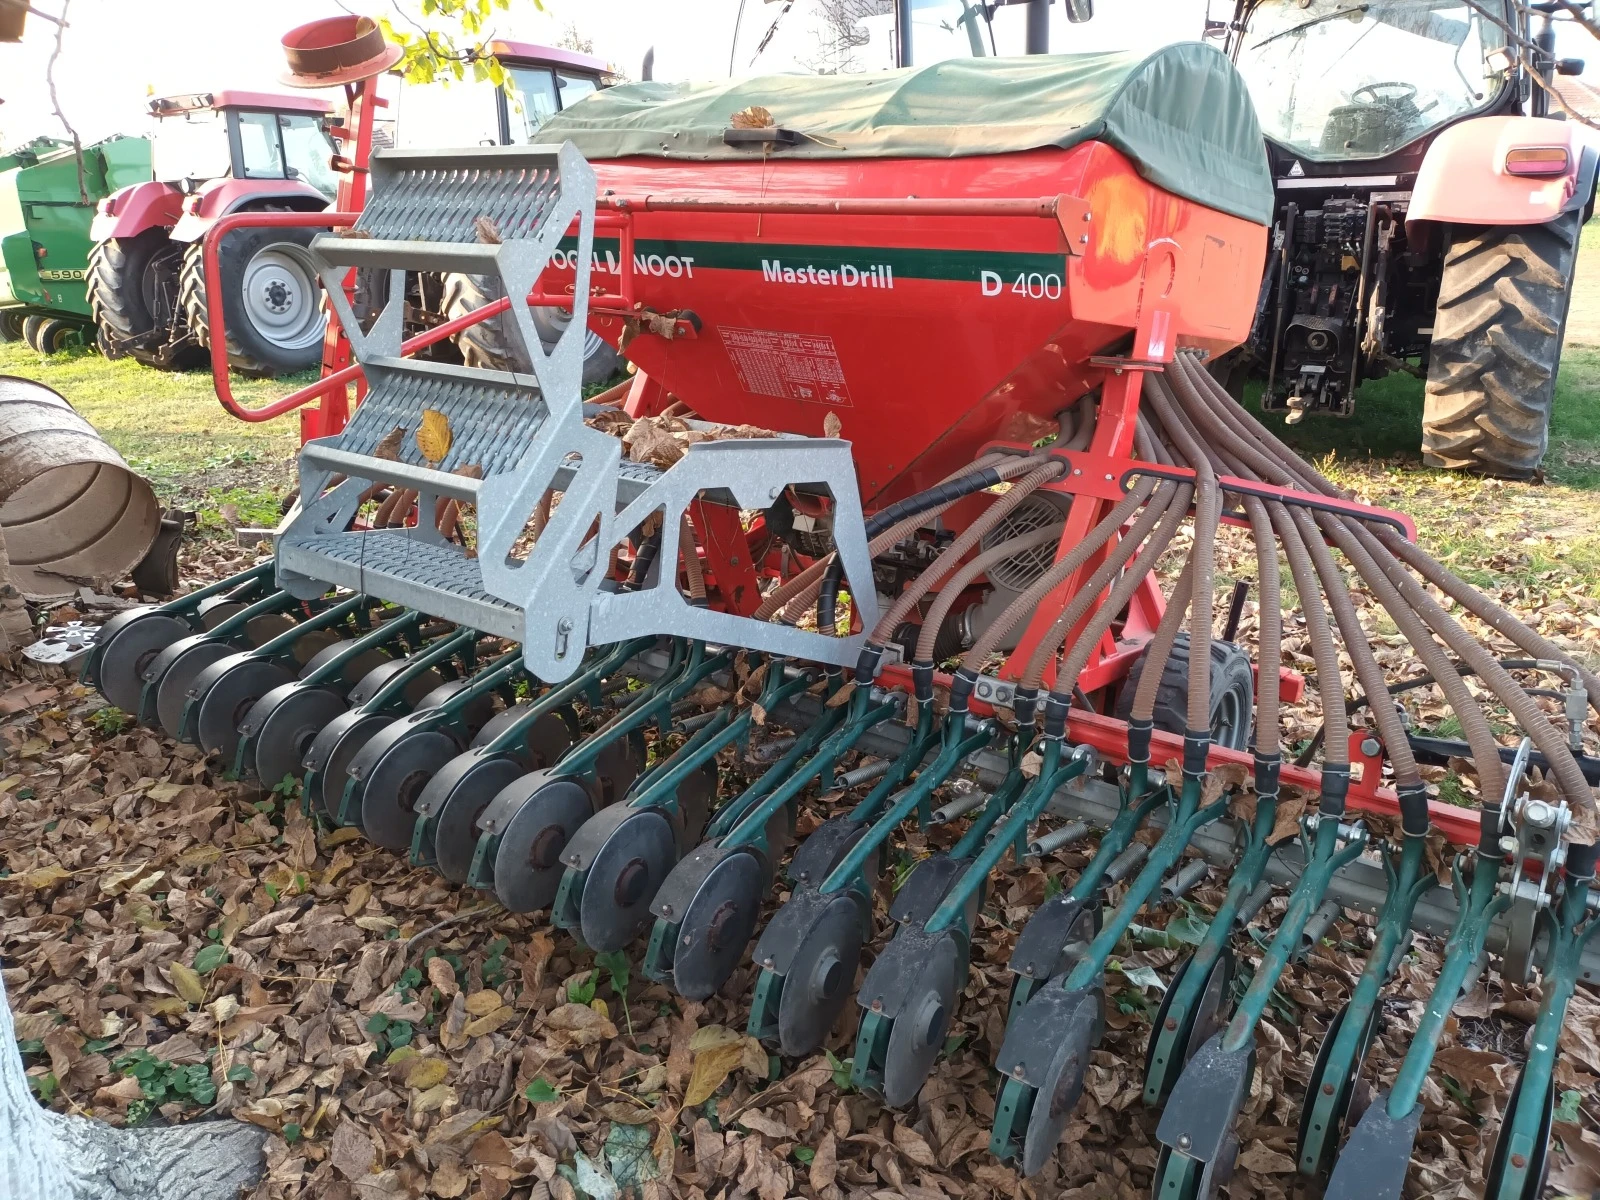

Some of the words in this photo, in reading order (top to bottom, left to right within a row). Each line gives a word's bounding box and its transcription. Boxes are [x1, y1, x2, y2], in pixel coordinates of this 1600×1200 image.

[633, 254, 694, 278] NOOT
[761, 259, 893, 288] MasterDrill
[981, 270, 1003, 296] D
[1011, 272, 1061, 299] 400
